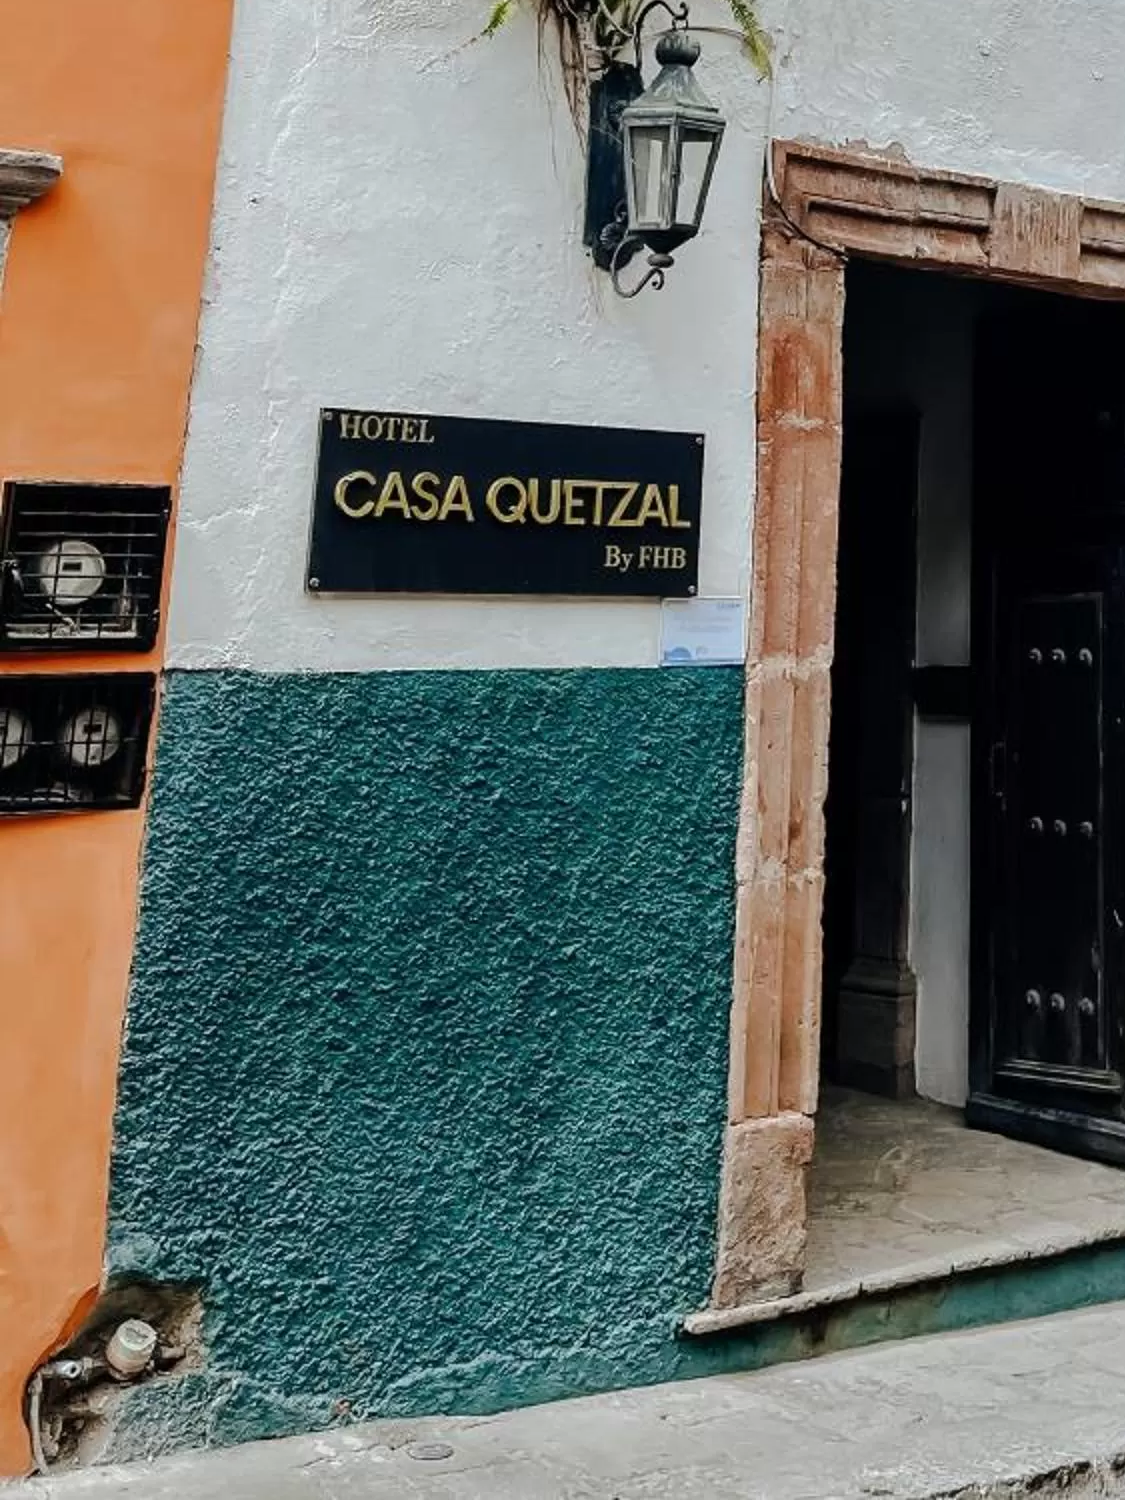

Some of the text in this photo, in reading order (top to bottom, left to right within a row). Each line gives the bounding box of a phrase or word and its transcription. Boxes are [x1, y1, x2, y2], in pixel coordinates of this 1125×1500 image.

[339, 412, 435, 443] HOTEL
[333, 470, 692, 528] CASA QUETZAL
[603, 544, 687, 572] By FHB
